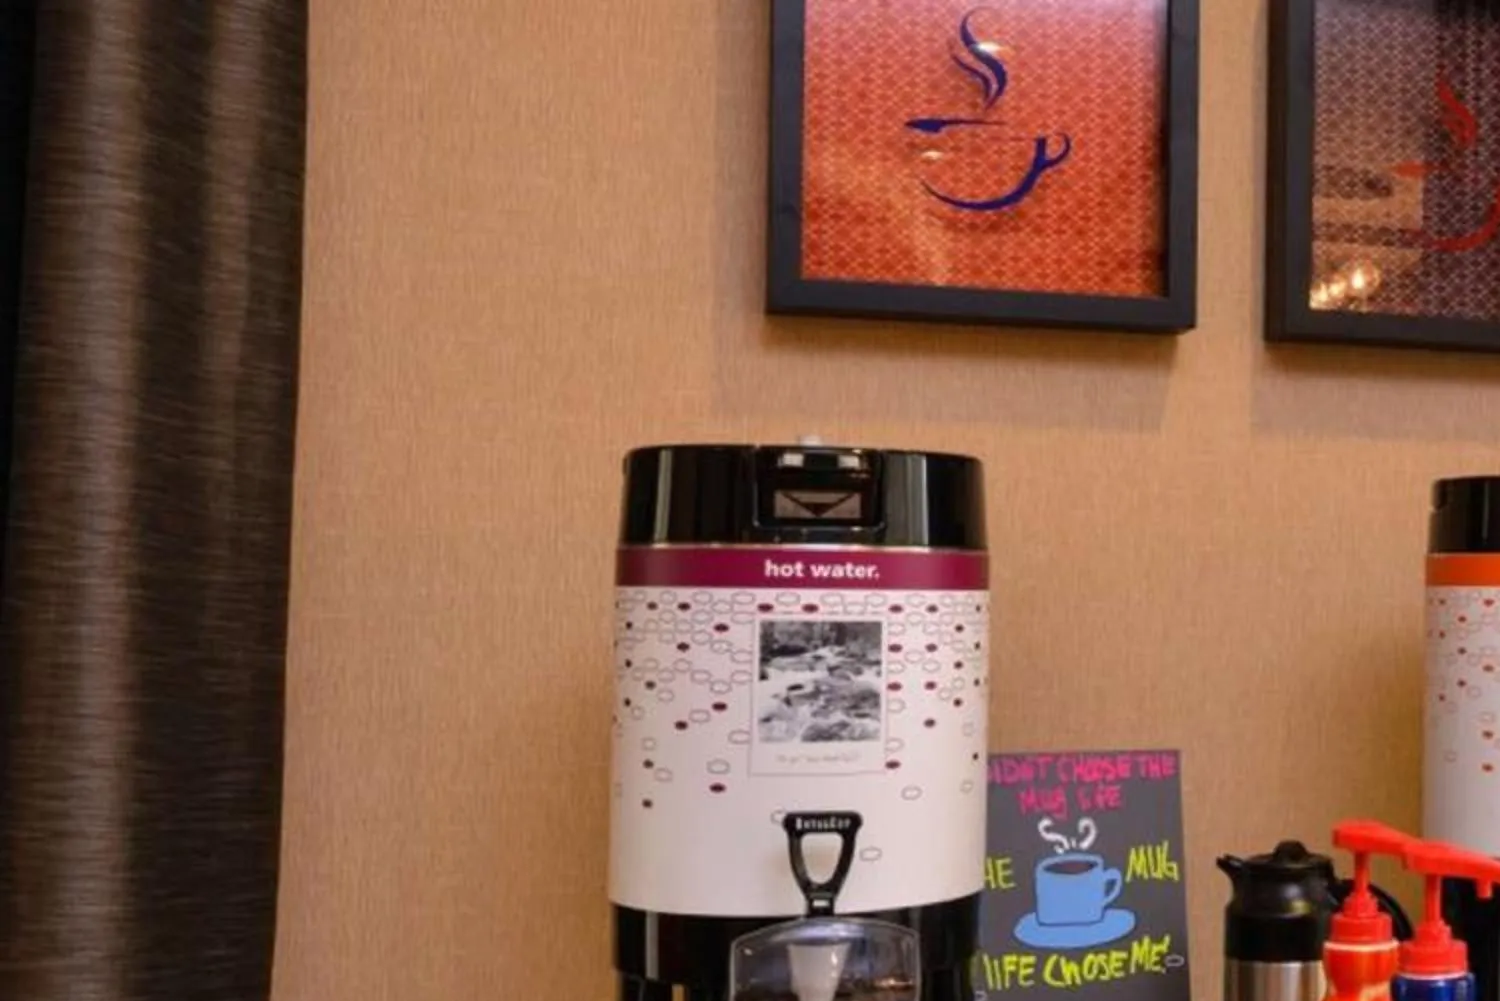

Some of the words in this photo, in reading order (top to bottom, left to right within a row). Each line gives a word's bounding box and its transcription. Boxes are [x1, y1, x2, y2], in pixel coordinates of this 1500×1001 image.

[764, 558, 804, 578] hot
[808, 560, 880, 580] water.
[1133, 751, 1178, 779] THE
